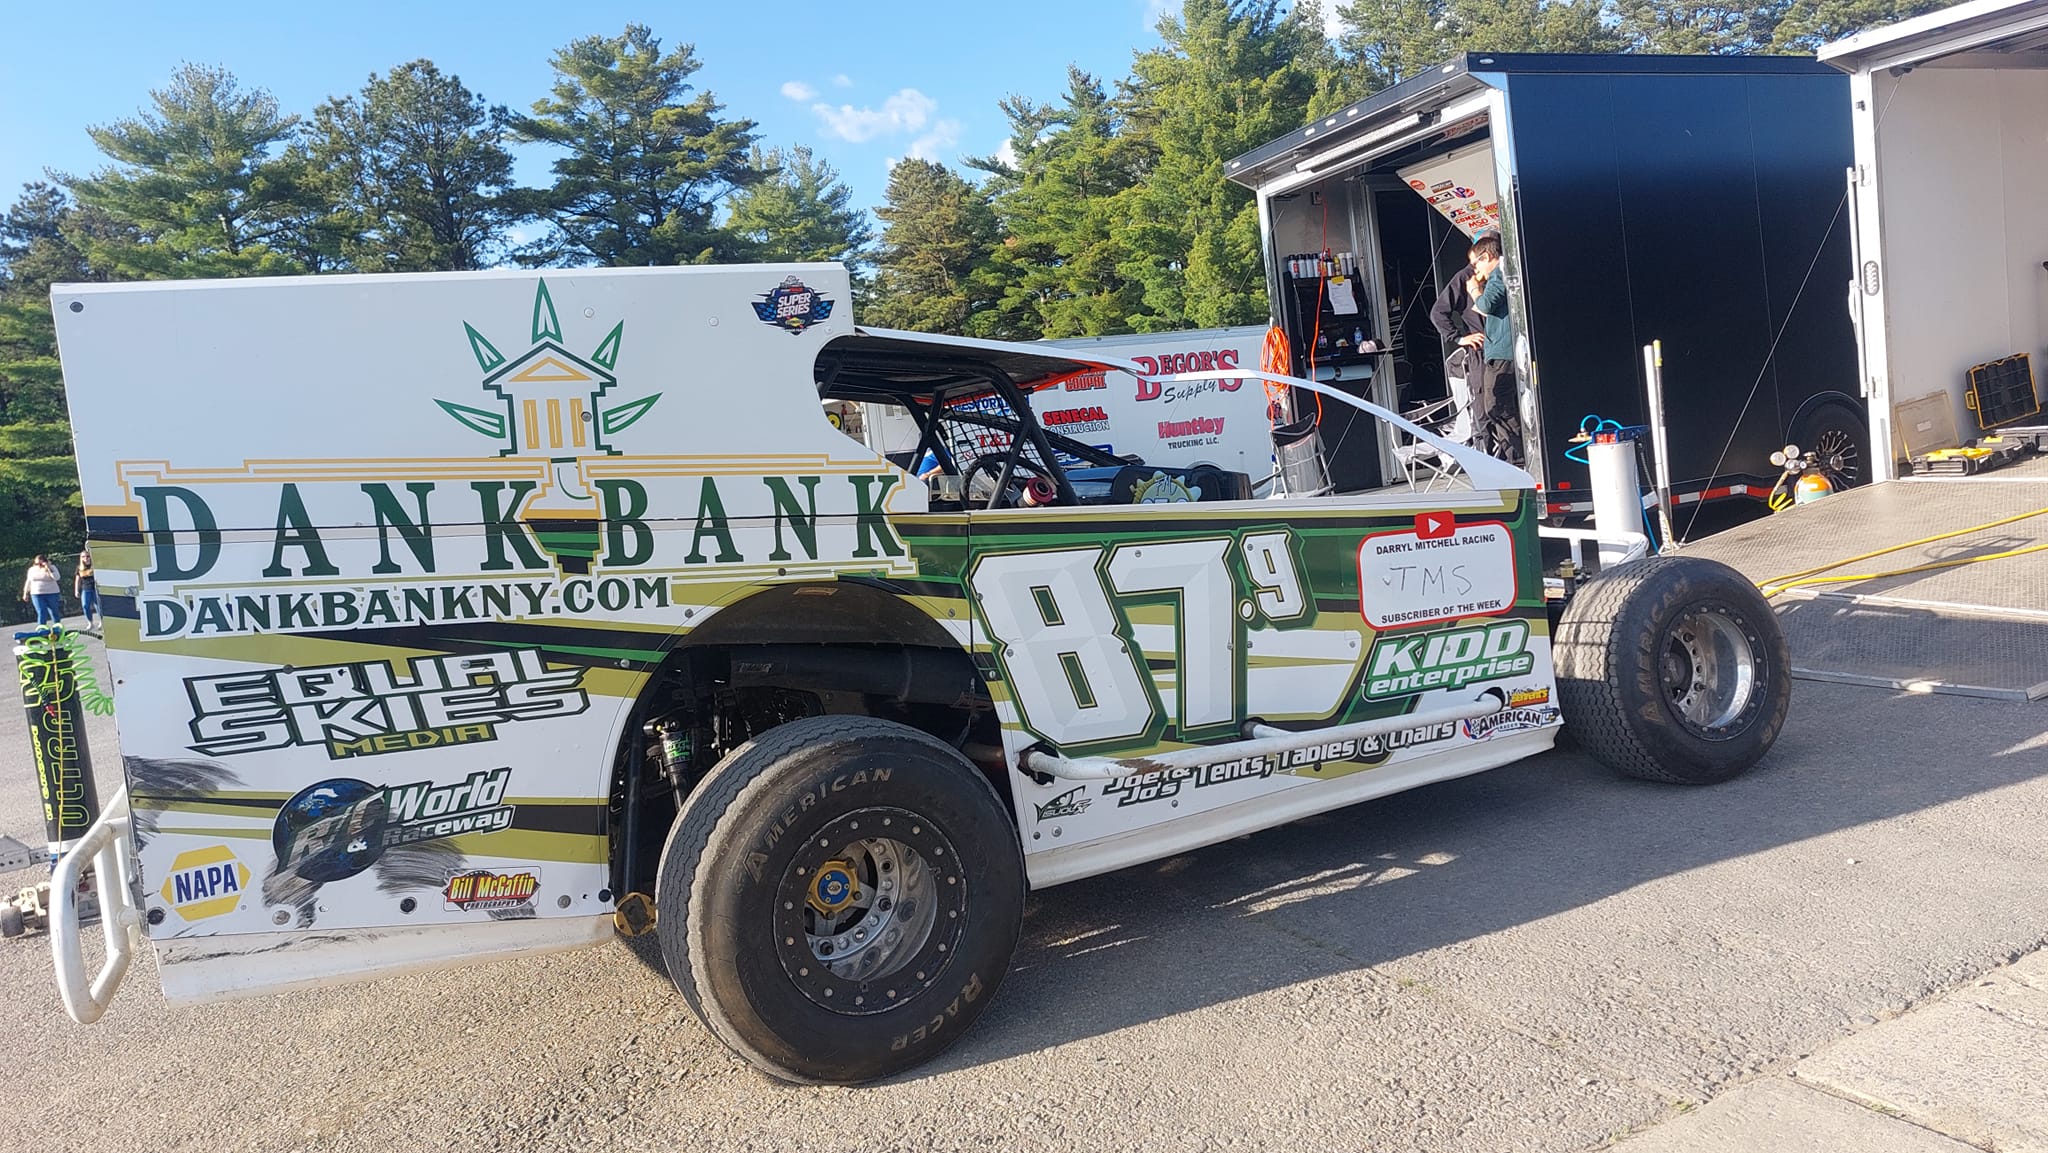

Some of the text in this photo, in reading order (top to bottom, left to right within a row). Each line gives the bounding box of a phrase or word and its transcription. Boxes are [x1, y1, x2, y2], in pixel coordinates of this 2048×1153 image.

[776, 303, 810, 318] SERIES
[777, 292, 811, 307] SUPER
[1164, 380, 1217, 403] Supply
[1042, 407, 1108, 426] SENECAL
[1158, 417, 1225, 439] Huntley
[1168, 439, 1204, 449] TRUCKING
[133, 475, 905, 582] DANK BANK
[1376, 533, 1496, 555] DARRYL MITCHELL RACING
[1390, 564, 1472, 596] TMS
[144, 576, 670, 638] DANKBANKNY.COM
[1381, 599, 1502, 624] SUBSCRIBER OF THE WEEK
[1372, 624, 1526, 677] KIDD
[186, 650, 586, 715] EQUAL
[1370, 656, 1531, 695] enterprise
[186, 679, 590, 756] SKIES
[1478, 711, 1541, 736] AMERICAN
[333, 723, 490, 758] MEDIA
[1197, 755, 1271, 785] Tents,
[1282, 739, 1355, 768] Tables
[1363, 735, 1379, 752] &
[387, 769, 511, 824] World
[1123, 781, 1177, 803] Jo's
[382, 808, 513, 846] Raceway
[743, 767, 894, 883] AMERICAN
[174, 862, 238, 904] NAPA
[450, 872, 536, 900] Bill McGaffin
[465, 900, 516, 910] PHOTOGRAPHY
[892, 973, 983, 1050] RACER
